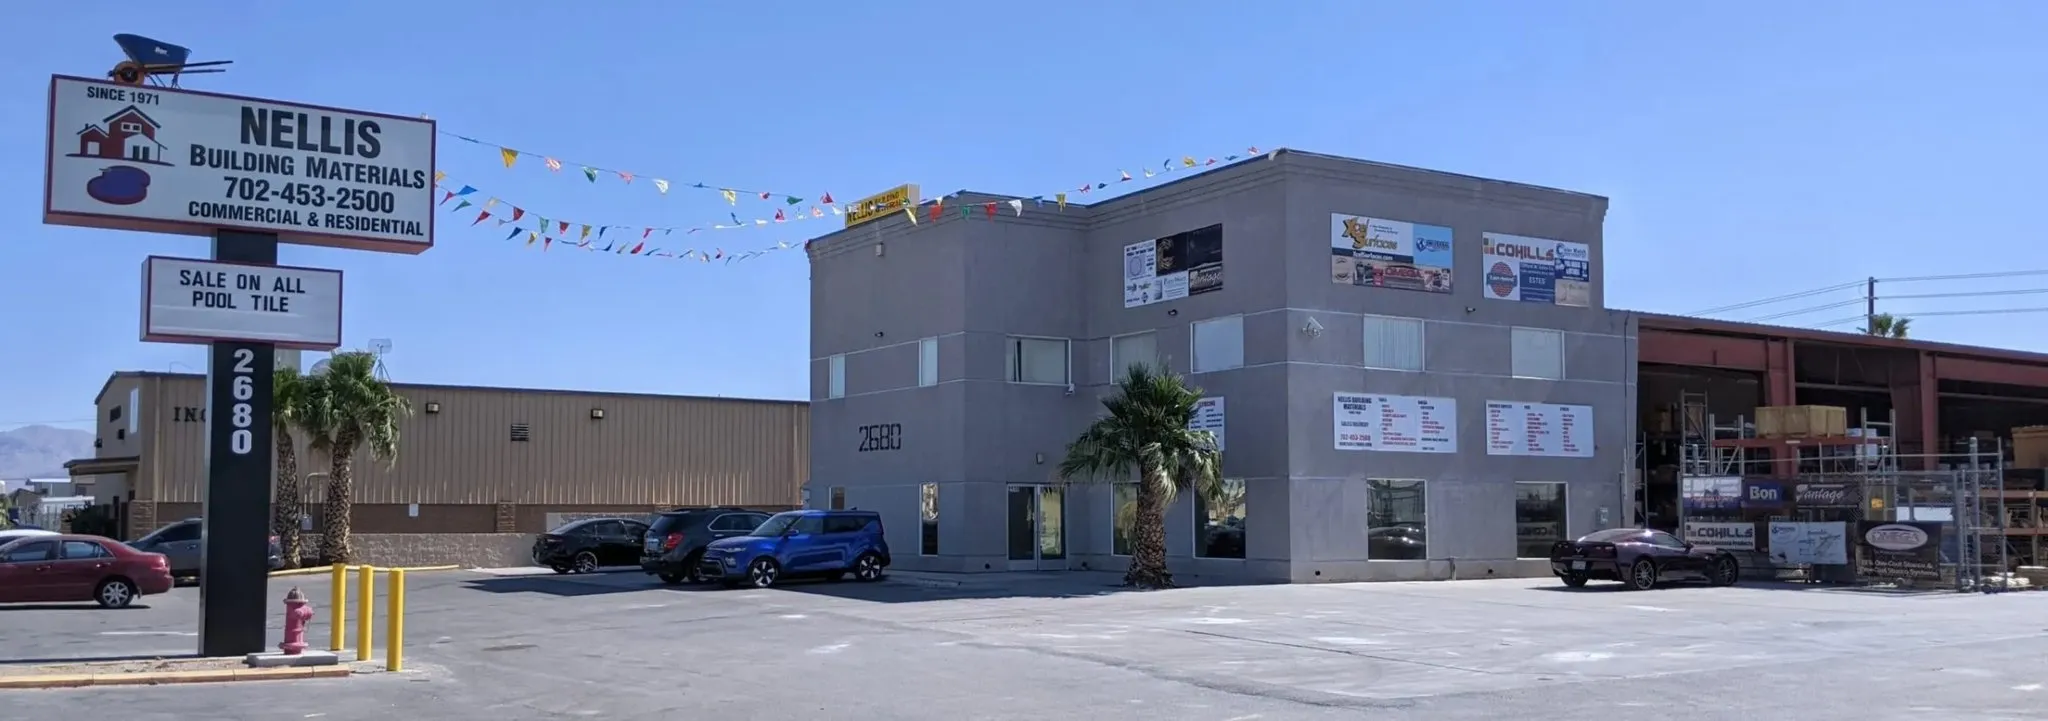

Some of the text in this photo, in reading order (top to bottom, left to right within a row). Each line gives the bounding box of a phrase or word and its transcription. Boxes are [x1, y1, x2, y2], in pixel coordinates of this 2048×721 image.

[87, 86, 159, 106] SINCE 1971
[241, 106, 381, 159] NELLIS
[190, 143, 425, 189] BUILDING MATERIALS
[224, 176, 394, 214] 702-453-2500
[188, 201, 424, 237] COMMERCIAL & RESIDENTIAL
[1496, 243, 1554, 261] COHILLS
[180, 270, 305, 294] SALE ON ALL
[192, 290, 289, 312] POOL TILE
[232, 348, 254, 454] 2680
[859, 423, 901, 452] 2680
[1749, 485, 1777, 500] Bon
[1698, 527, 1753, 539] COHILLS
